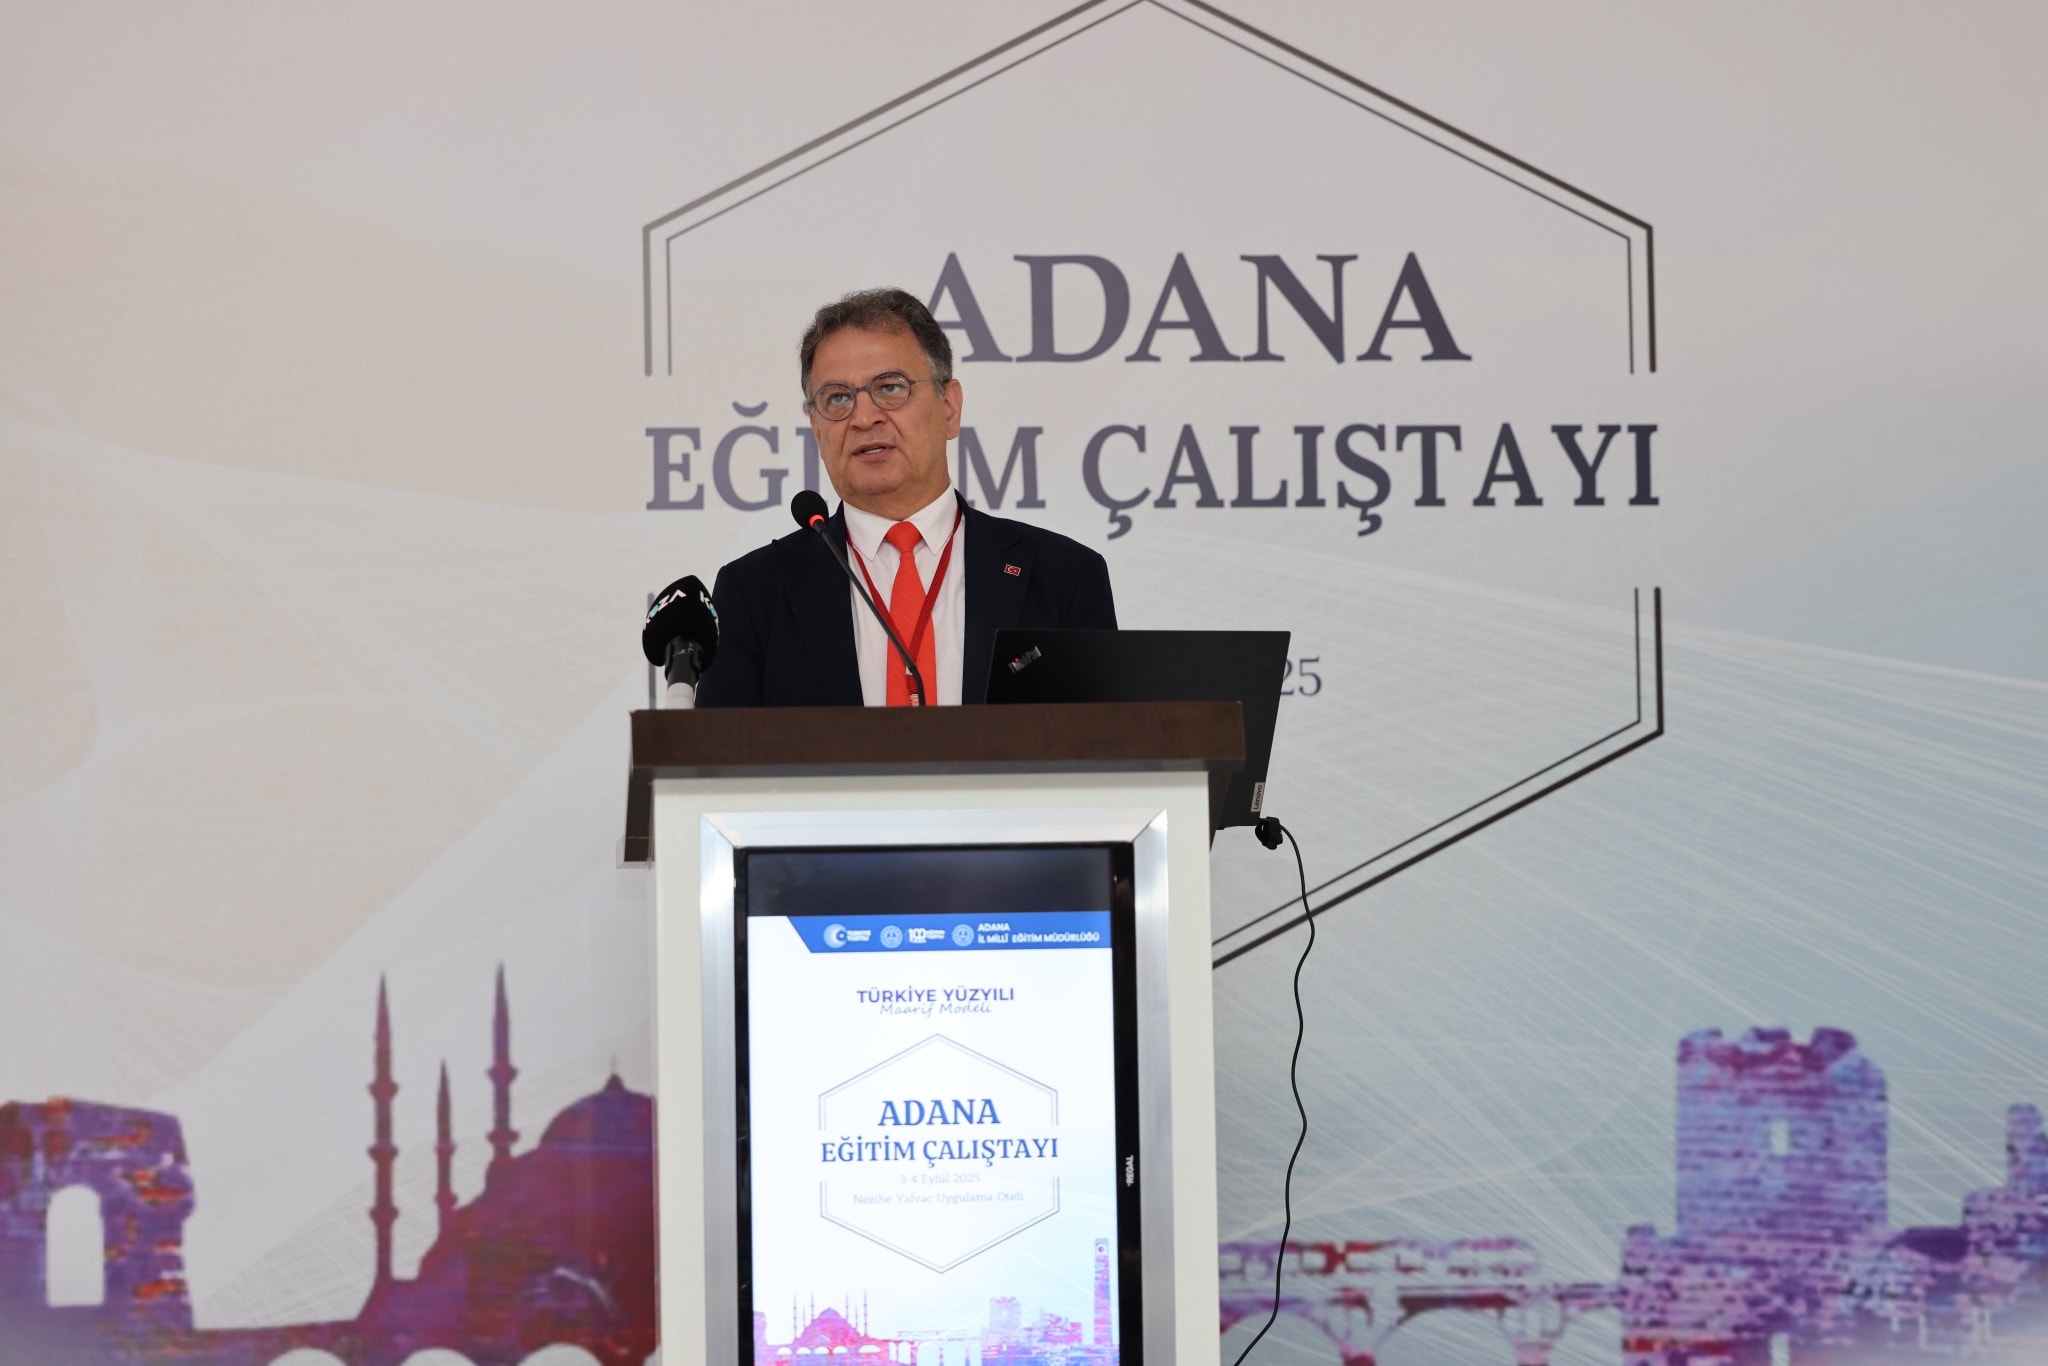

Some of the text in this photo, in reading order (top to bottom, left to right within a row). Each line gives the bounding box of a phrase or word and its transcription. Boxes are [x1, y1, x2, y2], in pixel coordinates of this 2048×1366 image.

[927, 252, 1473, 364] ADANA
[645, 401, 1660, 540] EĞİM ÇALIŞTAYI
[1253, 784, 1263, 810] Lenovo
[977, 922, 1011, 932] ADANA
[1011, 932, 1042, 943] EĞİTİM
[1043, 931, 1100, 942] MÜDÜRLÜĞÜ
[857, 984, 1014, 1003] TÜRKİYE YÜZYILI
[880, 1000, 993, 1017] Maarif Modeli
[877, 1098, 1001, 1127] ADANA
[821, 1135, 1059, 1168] EĞİTİM ÇALIŞTAYI
[921, 1173, 950, 1185] Eylül
[953, 1172, 981, 1183] 2025
[1125, 1154, 1135, 1185] REGAL
[936, 1191, 993, 1205] Uygulama
[997, 1190, 1024, 1201] Oteli
